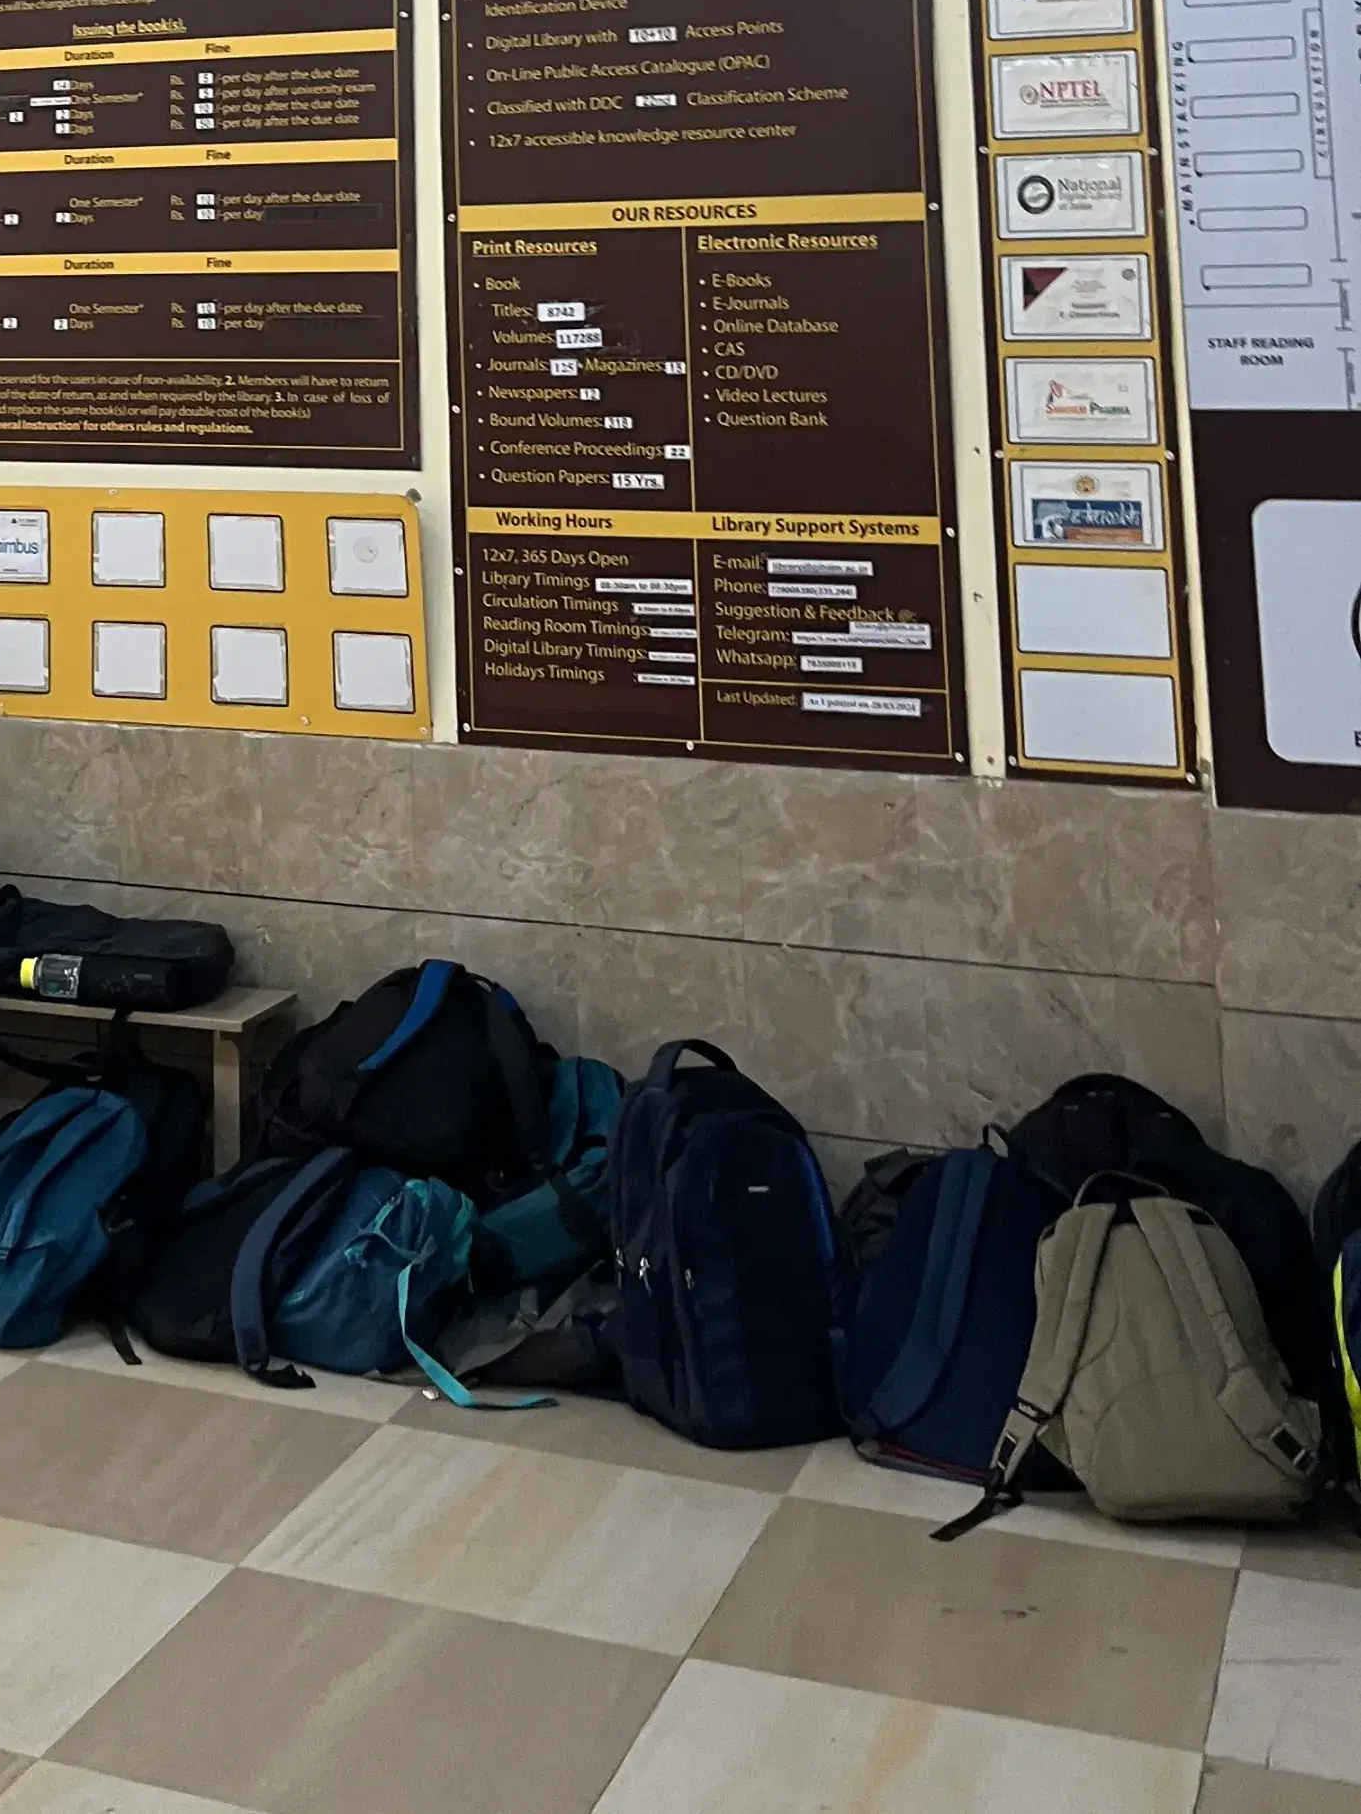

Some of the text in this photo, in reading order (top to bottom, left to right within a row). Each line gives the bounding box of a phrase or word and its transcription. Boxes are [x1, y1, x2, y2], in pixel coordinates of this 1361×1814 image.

[485, 0, 577, 17] Identification
[73, 23, 114, 39] Issuing
[116, 21, 136, 34] the
[485, 34, 531, 52] Digital
[533, 32, 583, 48] Library
[585, 28, 618, 43] with
[685, 24, 734, 39] Access
[736, 20, 785, 35] Points
[65, 49, 114, 62] Duration
[205, 43, 230, 54] Fine
[486, 54, 771, 82] On-Line Public Access Catalogue (OPAC)
[687, 89, 785, 106] Classification
[787, 86, 849, 101] Scheme
[1040, 80, 1102, 99] NPTEL
[487, 98, 552, 116] Classified
[554, 97, 587, 112] with
[589, 95, 624, 111] DDC
[489, 124, 797, 148] 12x7 accessible knowledge resource center
[64, 153, 114, 165] Duration
[206, 149, 231, 161] Fine
[1058, 175, 1122, 192] National
[611, 203, 758, 224] OUR RESOURCES
[472, 239, 598, 255] Print Resources
[697, 233, 879, 250] Electronic Resources
[64, 259, 114, 271] Duration
[207, 257, 232, 268] Fine
[485, 276, 521, 291] Book
[712, 273, 772, 288] E-Books
[713, 295, 790, 311] E-Journals
[547, 307, 575, 318] 8742
[713, 318, 839, 334] Online Database
[714, 341, 745, 357] CAS
[1207, 336, 1315, 352] STAFF READING
[488, 358, 549, 373] Journals:
[585, 358, 664, 375] Magazines:
[1239, 352, 1284, 367] ROOM
[715, 364, 779, 380] CD/DVD
[489, 386, 578, 402] Newspapers:
[716, 387, 828, 404] Video Lectures
[490, 413, 602, 428] Bound Volumes:
[717, 411, 829, 427] Question Bank
[490, 440, 570, 455] Conference
[573, 442, 663, 460] Proceedings:
[491, 468, 659, 488] Question Papers: 15 Yrs.
[496, 511, 613, 531] Working Hours
[712, 516, 920, 539] Library Support Systems
[482, 548, 629, 569] 12x7, 365 Days Open
[713, 554, 764, 571] E-mail:
[481, 571, 531, 589] Library
[533, 572, 590, 591] Timings
[714, 577, 766, 594] Phone:
[482, 593, 558, 611] Circulation
[561, 596, 619, 615] Timings
[715, 601, 801, 621] Suggestion
[804, 604, 815, 618] &
[819, 604, 895, 623] Feedback
[483, 616, 541, 636] Reading
[544, 618, 586, 634] Room
[716, 625, 790, 645] Telegram:
[484, 639, 530, 658] Digital
[533, 642, 583, 661] Library
[716, 648, 797, 669] Whatsapp:
[484, 663, 605, 685] Holidays Timings
[717, 690, 741, 704] Last
[743, 690, 798, 707] Updated:
